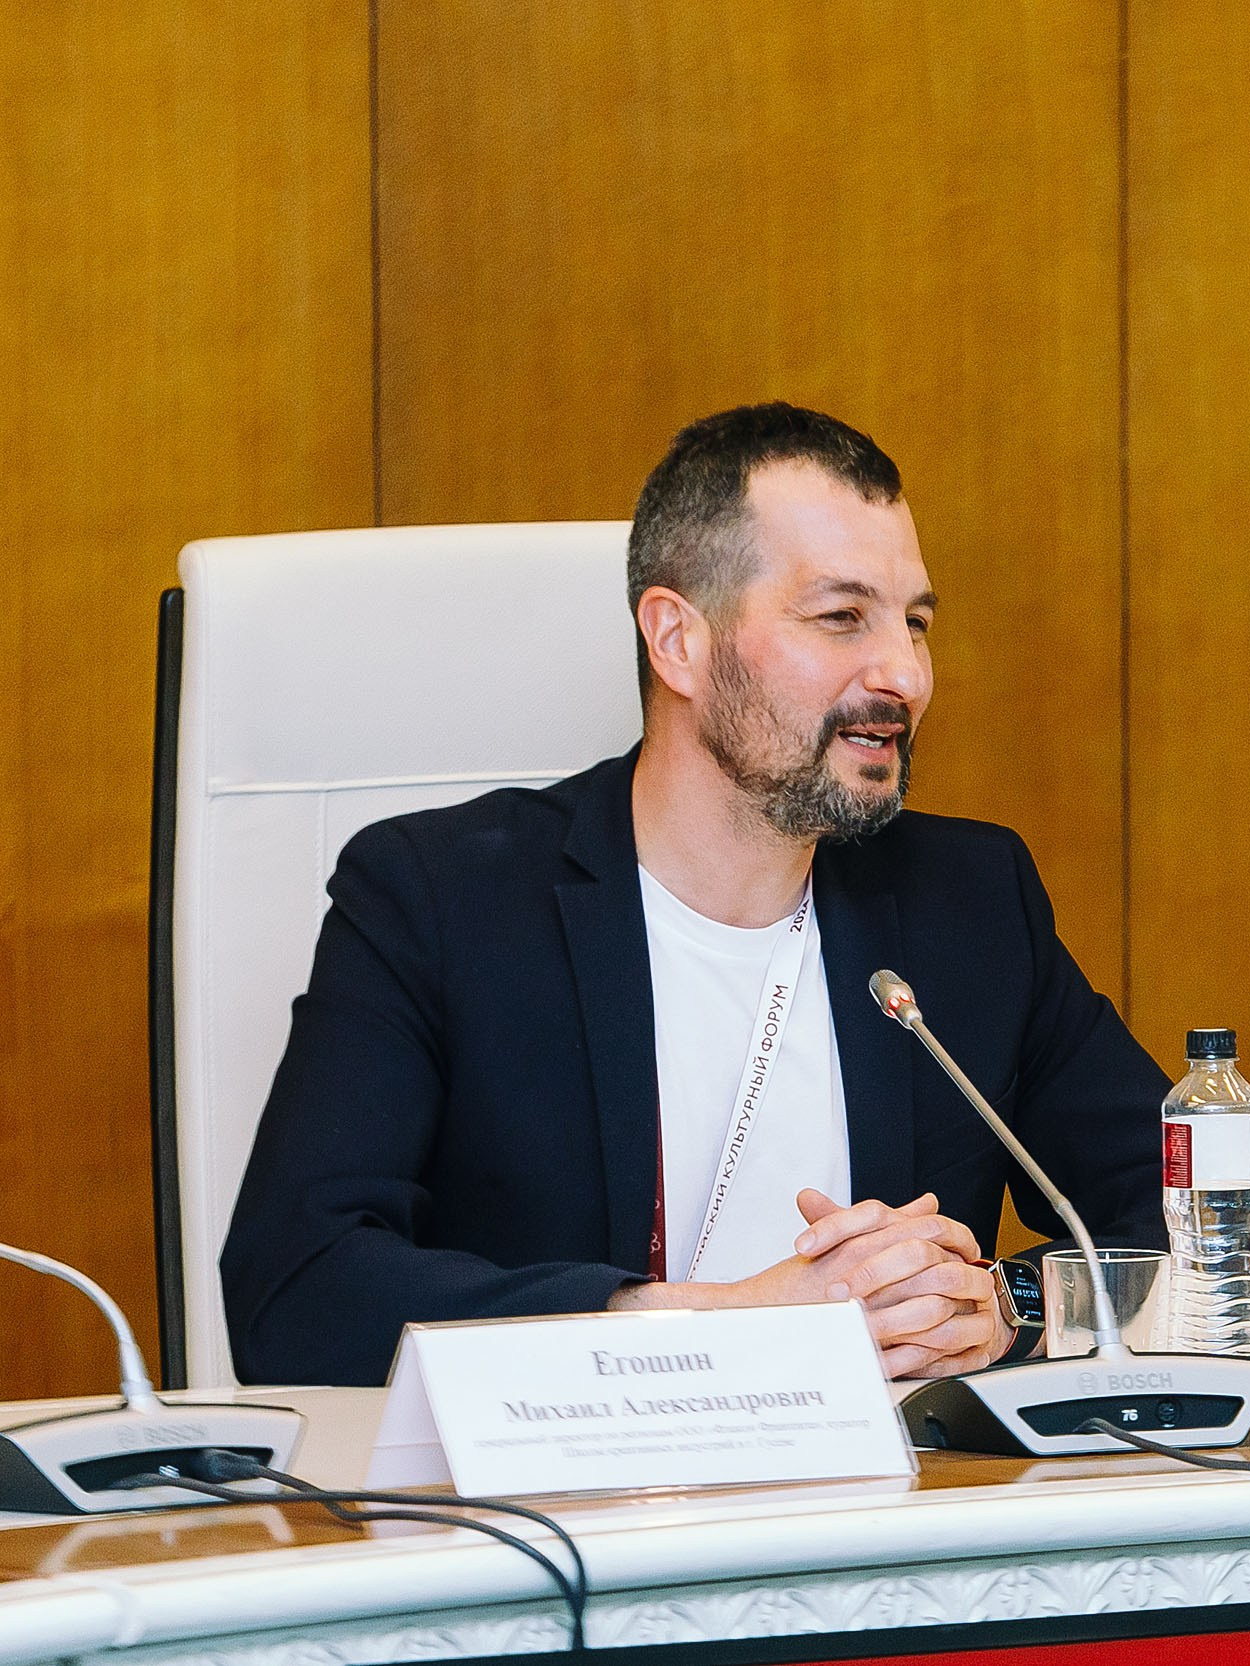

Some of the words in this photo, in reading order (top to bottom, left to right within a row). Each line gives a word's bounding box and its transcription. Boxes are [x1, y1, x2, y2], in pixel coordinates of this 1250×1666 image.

[723, 1055, 770, 1180] КУЛЬТУРНЫЙ
[761, 984, 789, 1051] ФОРУМ
[590, 1350, 714, 1376] Егошин
[1107, 1372, 1174, 1390] BOSCH
[502, 1399, 614, 1423] Михаил
[621, 1389, 826, 1417] Александрович
[1121, 1409, 1139, 1422] 76
